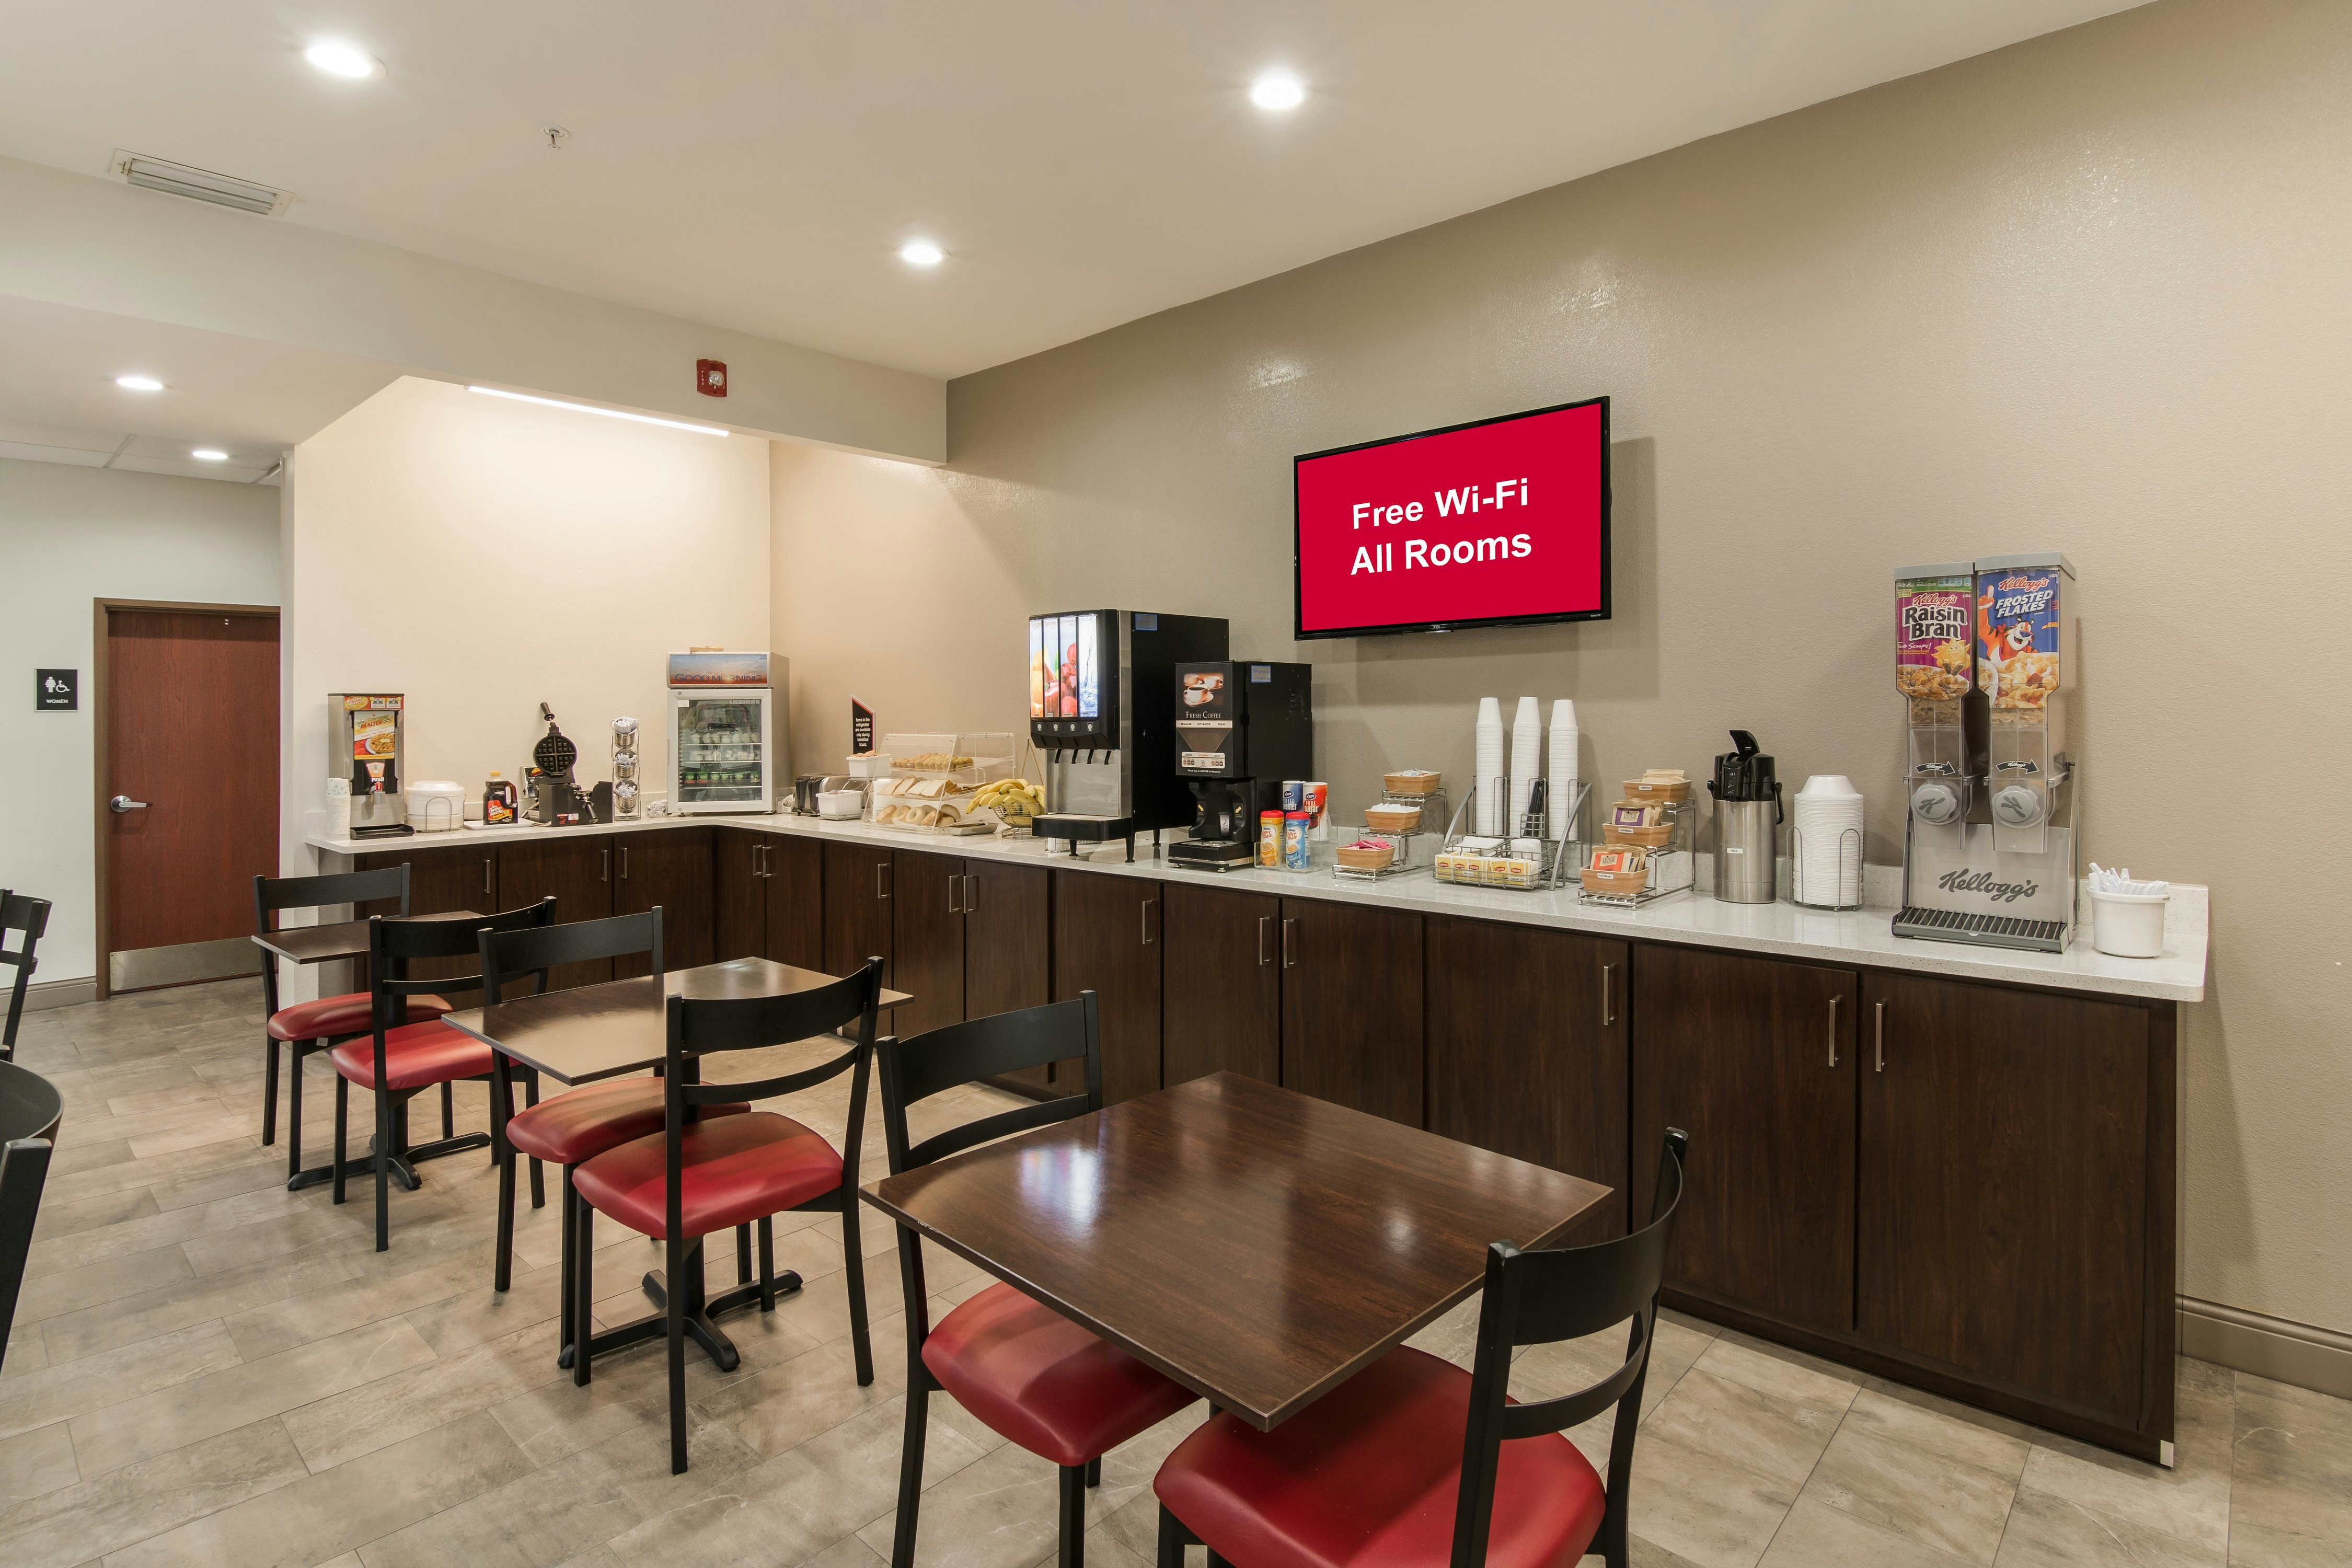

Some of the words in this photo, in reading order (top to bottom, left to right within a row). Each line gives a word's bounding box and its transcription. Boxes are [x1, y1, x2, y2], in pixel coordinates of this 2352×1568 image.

[1353, 501, 1423, 529] Free
[1434, 478, 1528, 517] Wi-Fi
[1351, 543, 1392, 575] All
[1405, 534, 1532, 569] Rooms
[1998, 576, 2049, 592] Kellogg's
[1912, 593, 1957, 607] Kellogg's
[1996, 590, 2053, 609] FROSTED
[1904, 605, 1967, 626] Raisin
[1997, 601, 2046, 618] FLAKES
[1910, 622, 1961, 640] Bran
[675, 673, 709, 682] GOOD
[360, 720, 383, 729] MALTED
[1304, 805, 1319, 815] sugar
[1939, 868, 2038, 903] Kellogg's
